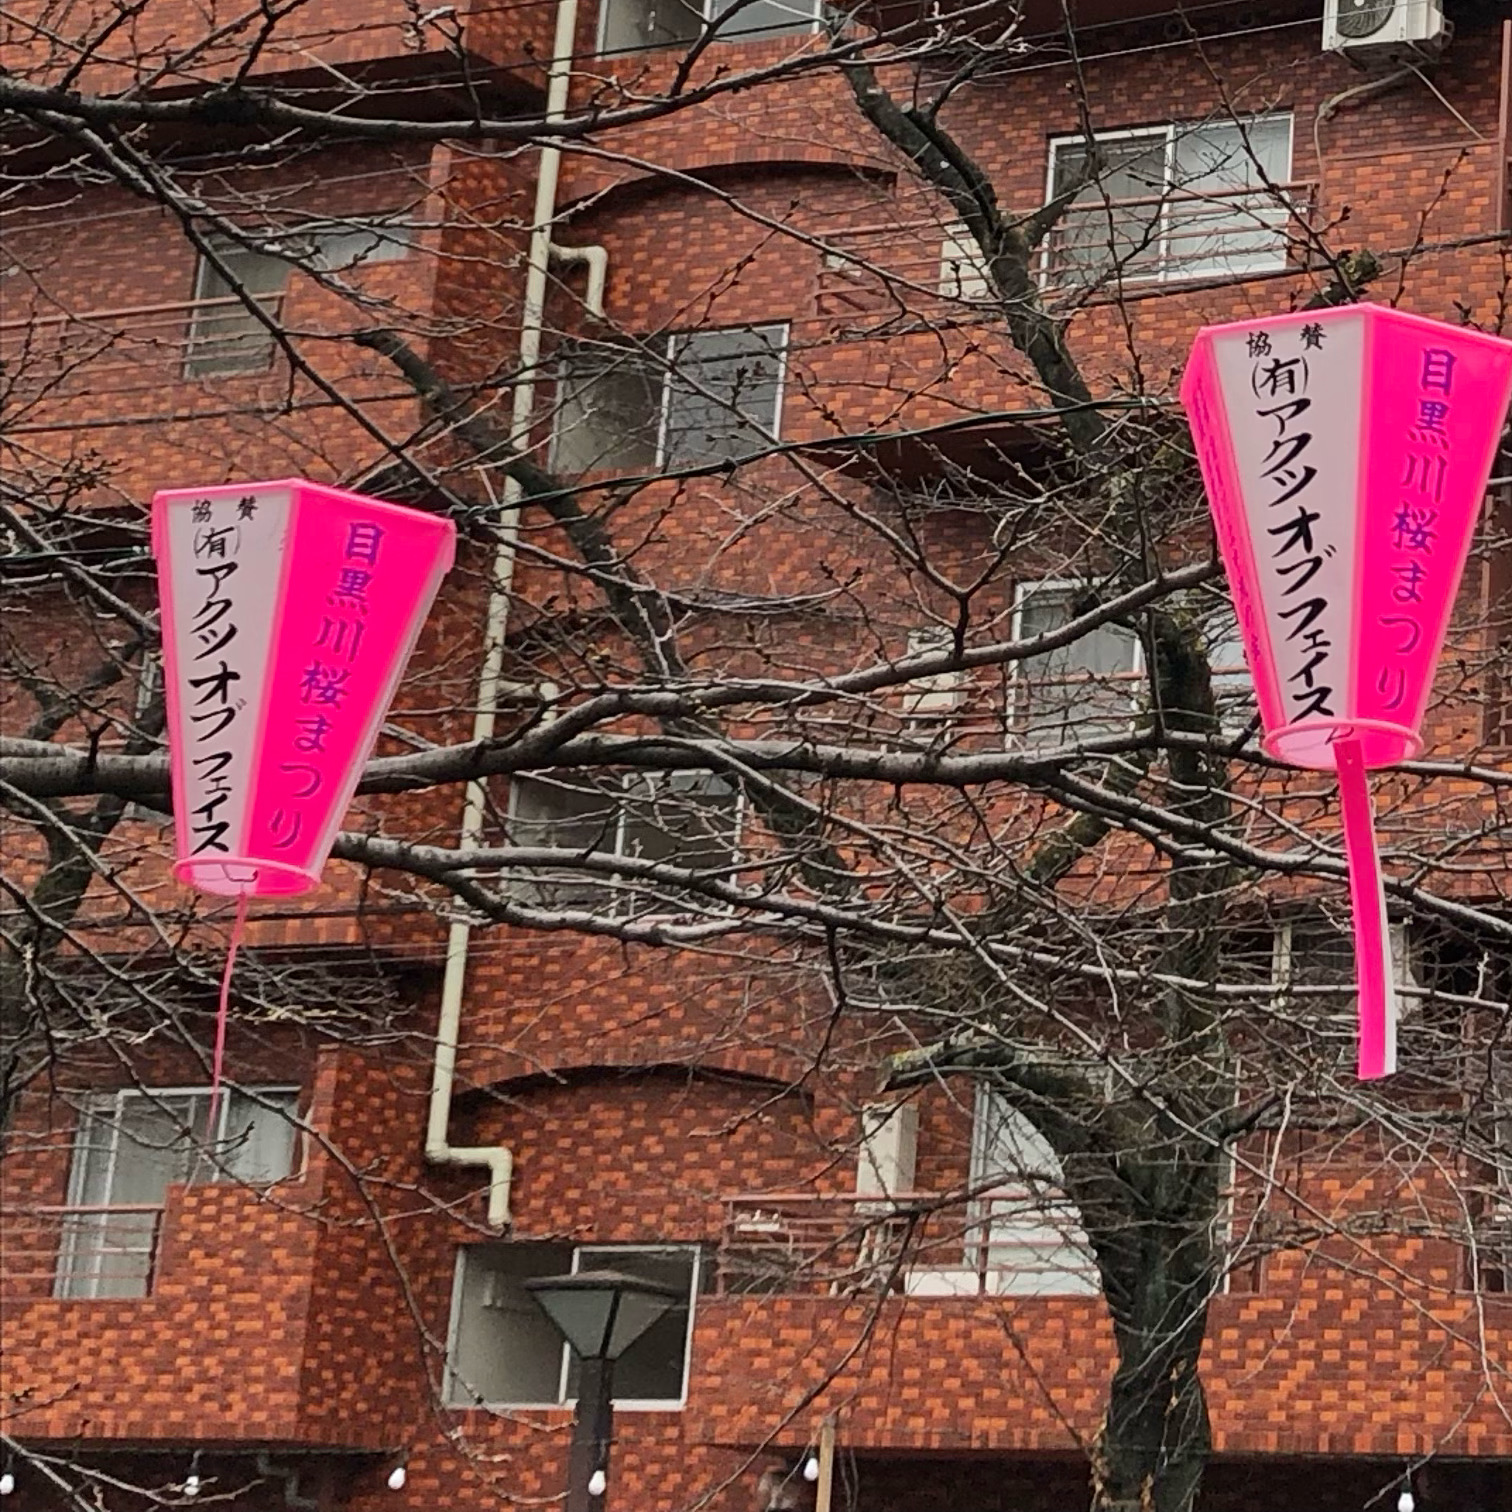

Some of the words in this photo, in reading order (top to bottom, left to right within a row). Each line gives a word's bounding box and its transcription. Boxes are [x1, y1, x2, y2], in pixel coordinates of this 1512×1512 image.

[1246, 324, 1327, 357] 協賛
[190, 496, 259, 524] 協賛
[1376, 347, 1457, 711] 目黒川桜まつり
[271, 520, 387, 851] 目黒川桜まつり
